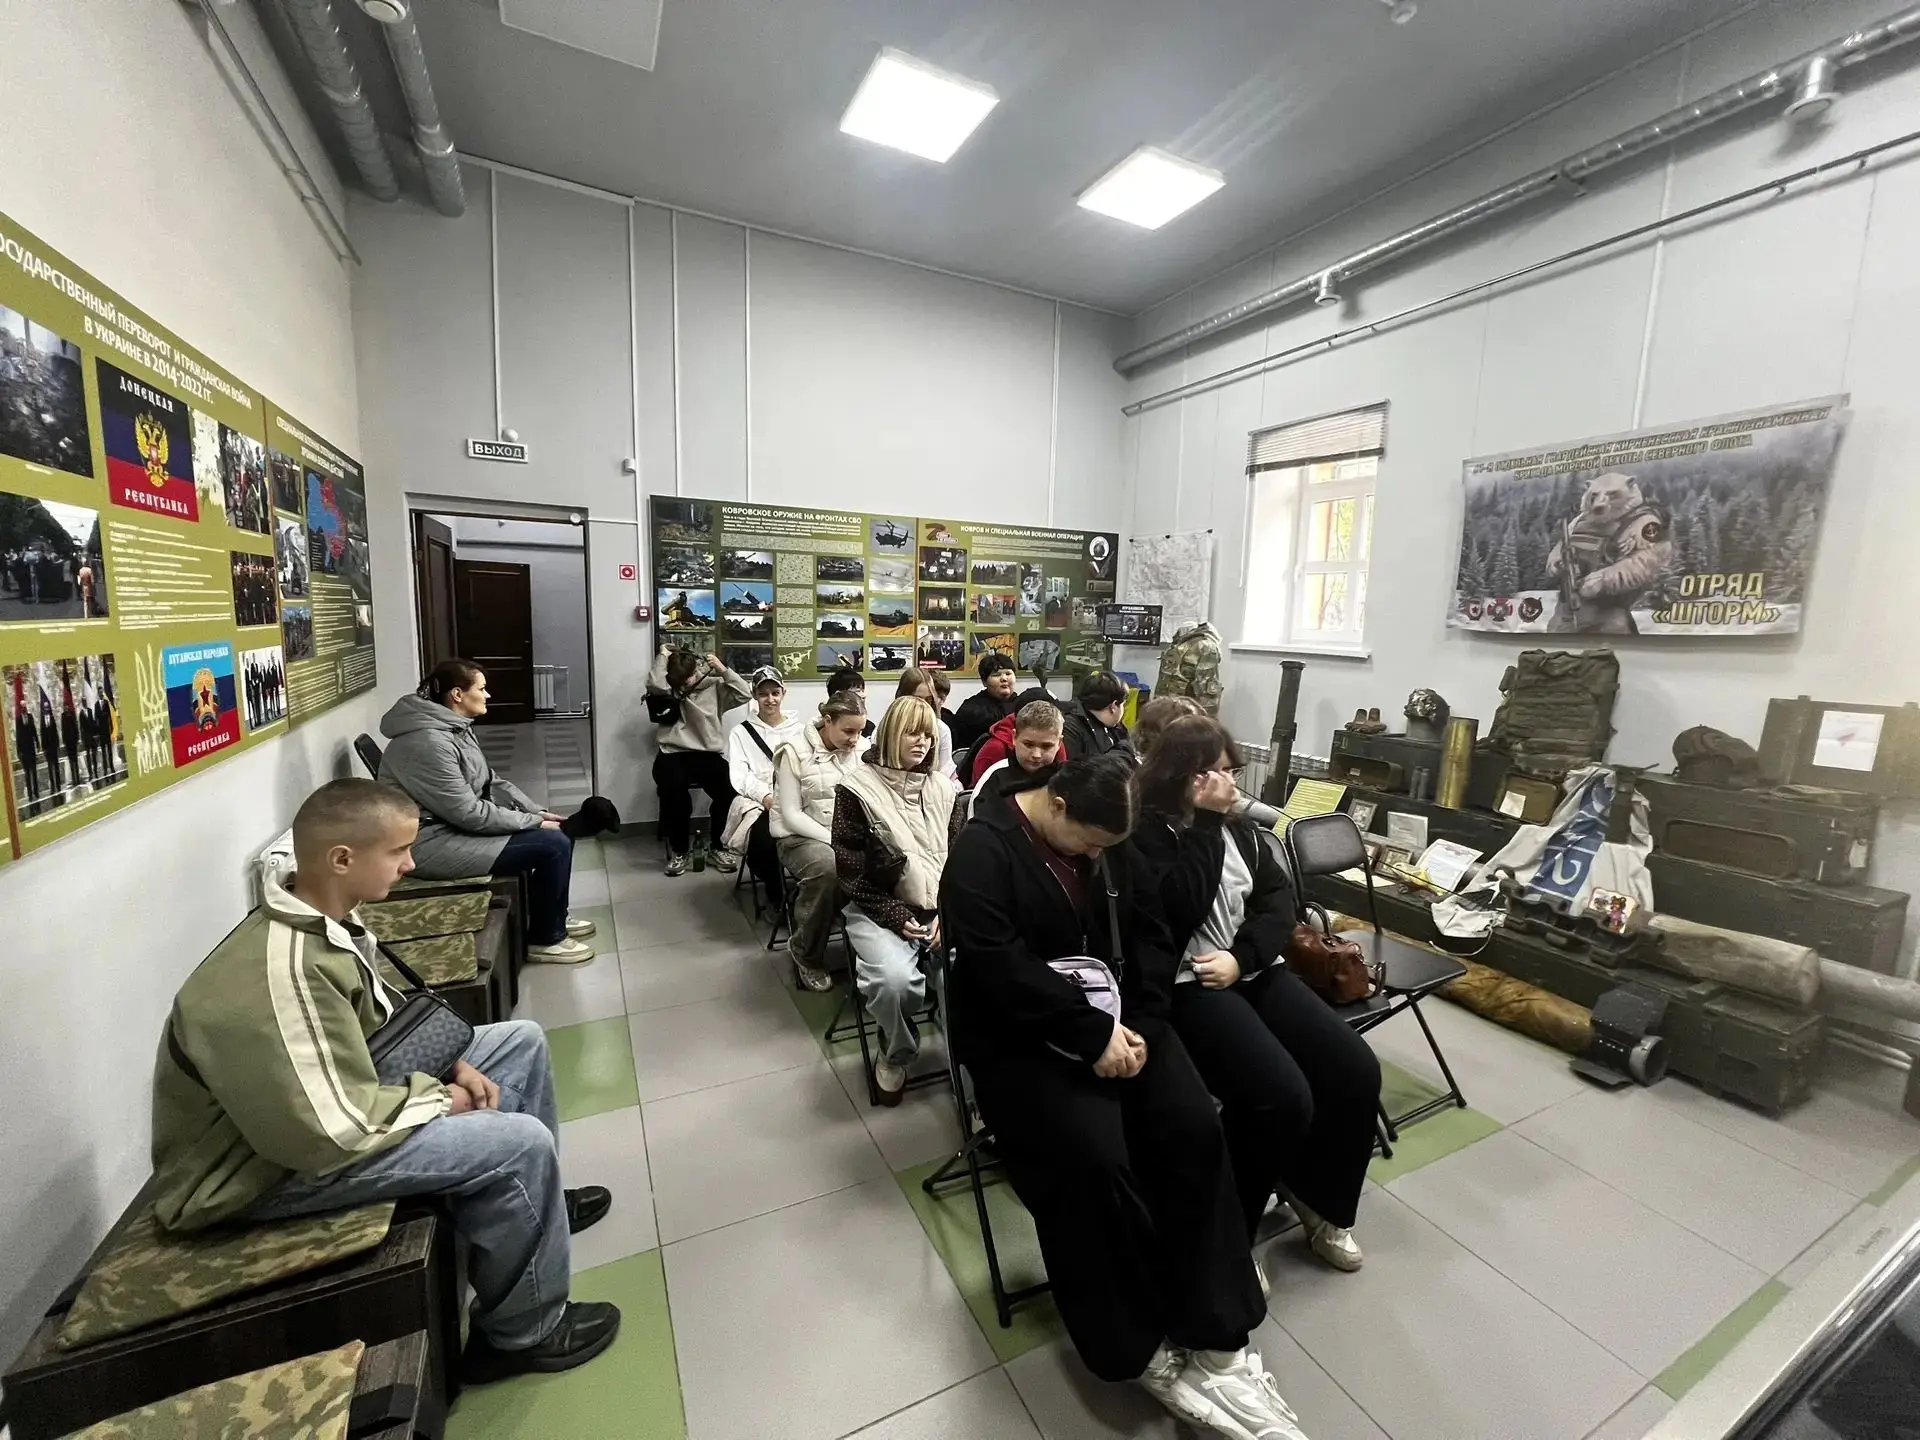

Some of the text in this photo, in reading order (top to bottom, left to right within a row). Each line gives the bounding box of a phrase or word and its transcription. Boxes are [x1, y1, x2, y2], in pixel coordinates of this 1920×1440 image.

[84, 315, 93, 335] В
[94, 320, 143, 362] УКРАИНЕ
[143, 351, 151, 367] В
[151, 354, 203, 399] 2014-2022
[117, 313, 171, 358] ПЕРЕВОРОТ
[174, 348, 181, 365] И
[181, 354, 231, 396] ГРАЖДАНСКАЯ
[231, 384, 252, 409] ВОЙНА
[120, 376, 174, 413] ДОНЕЦКАЯ
[474, 444, 522, 457] ВЫХОД
[124, 487, 189, 515] РЕСПУБЛИКА
[722, 506, 771, 516] КОВРОВСКОЕ
[772, 510, 803, 519] ОРУЖИЕ
[804, 513, 815, 521] НА
[815, 514, 848, 523] ФРОНТАХ
[960, 525, 985, 533] КОВРОВ
[1680, 572, 1765, 600] ОТРЯД
[1651, 601, 1782, 625] «ШТОРМ»
